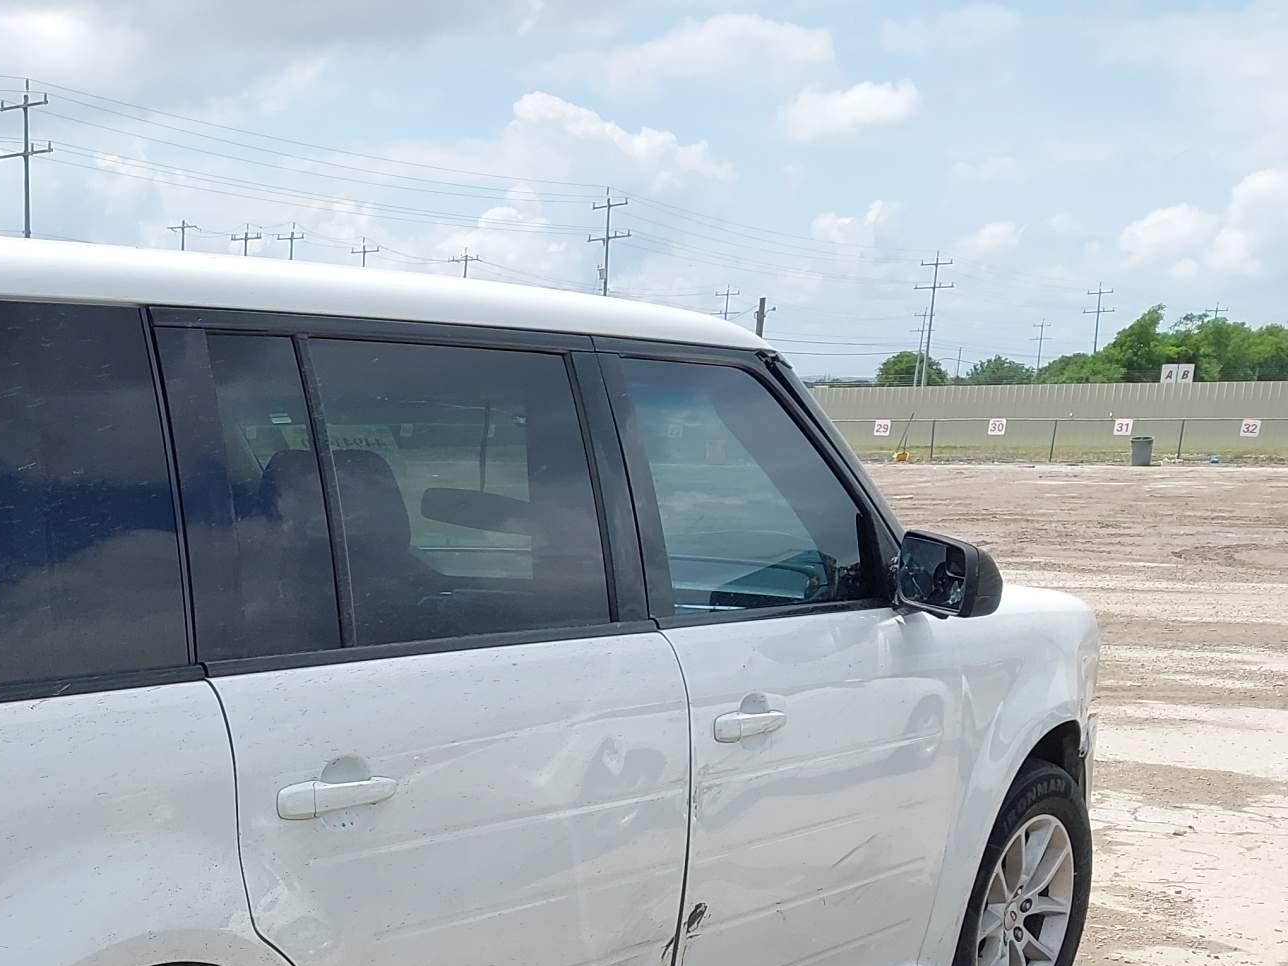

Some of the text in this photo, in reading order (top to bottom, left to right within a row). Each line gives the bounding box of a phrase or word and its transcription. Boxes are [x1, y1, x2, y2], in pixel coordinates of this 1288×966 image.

[1165, 369, 1174, 380] A
[1181, 369, 1190, 380] B
[875, 422, 890, 434] 29
[989, 422, 1005, 433] 30
[1115, 421, 1130, 433] 31
[1242, 423, 1259, 434] 32
